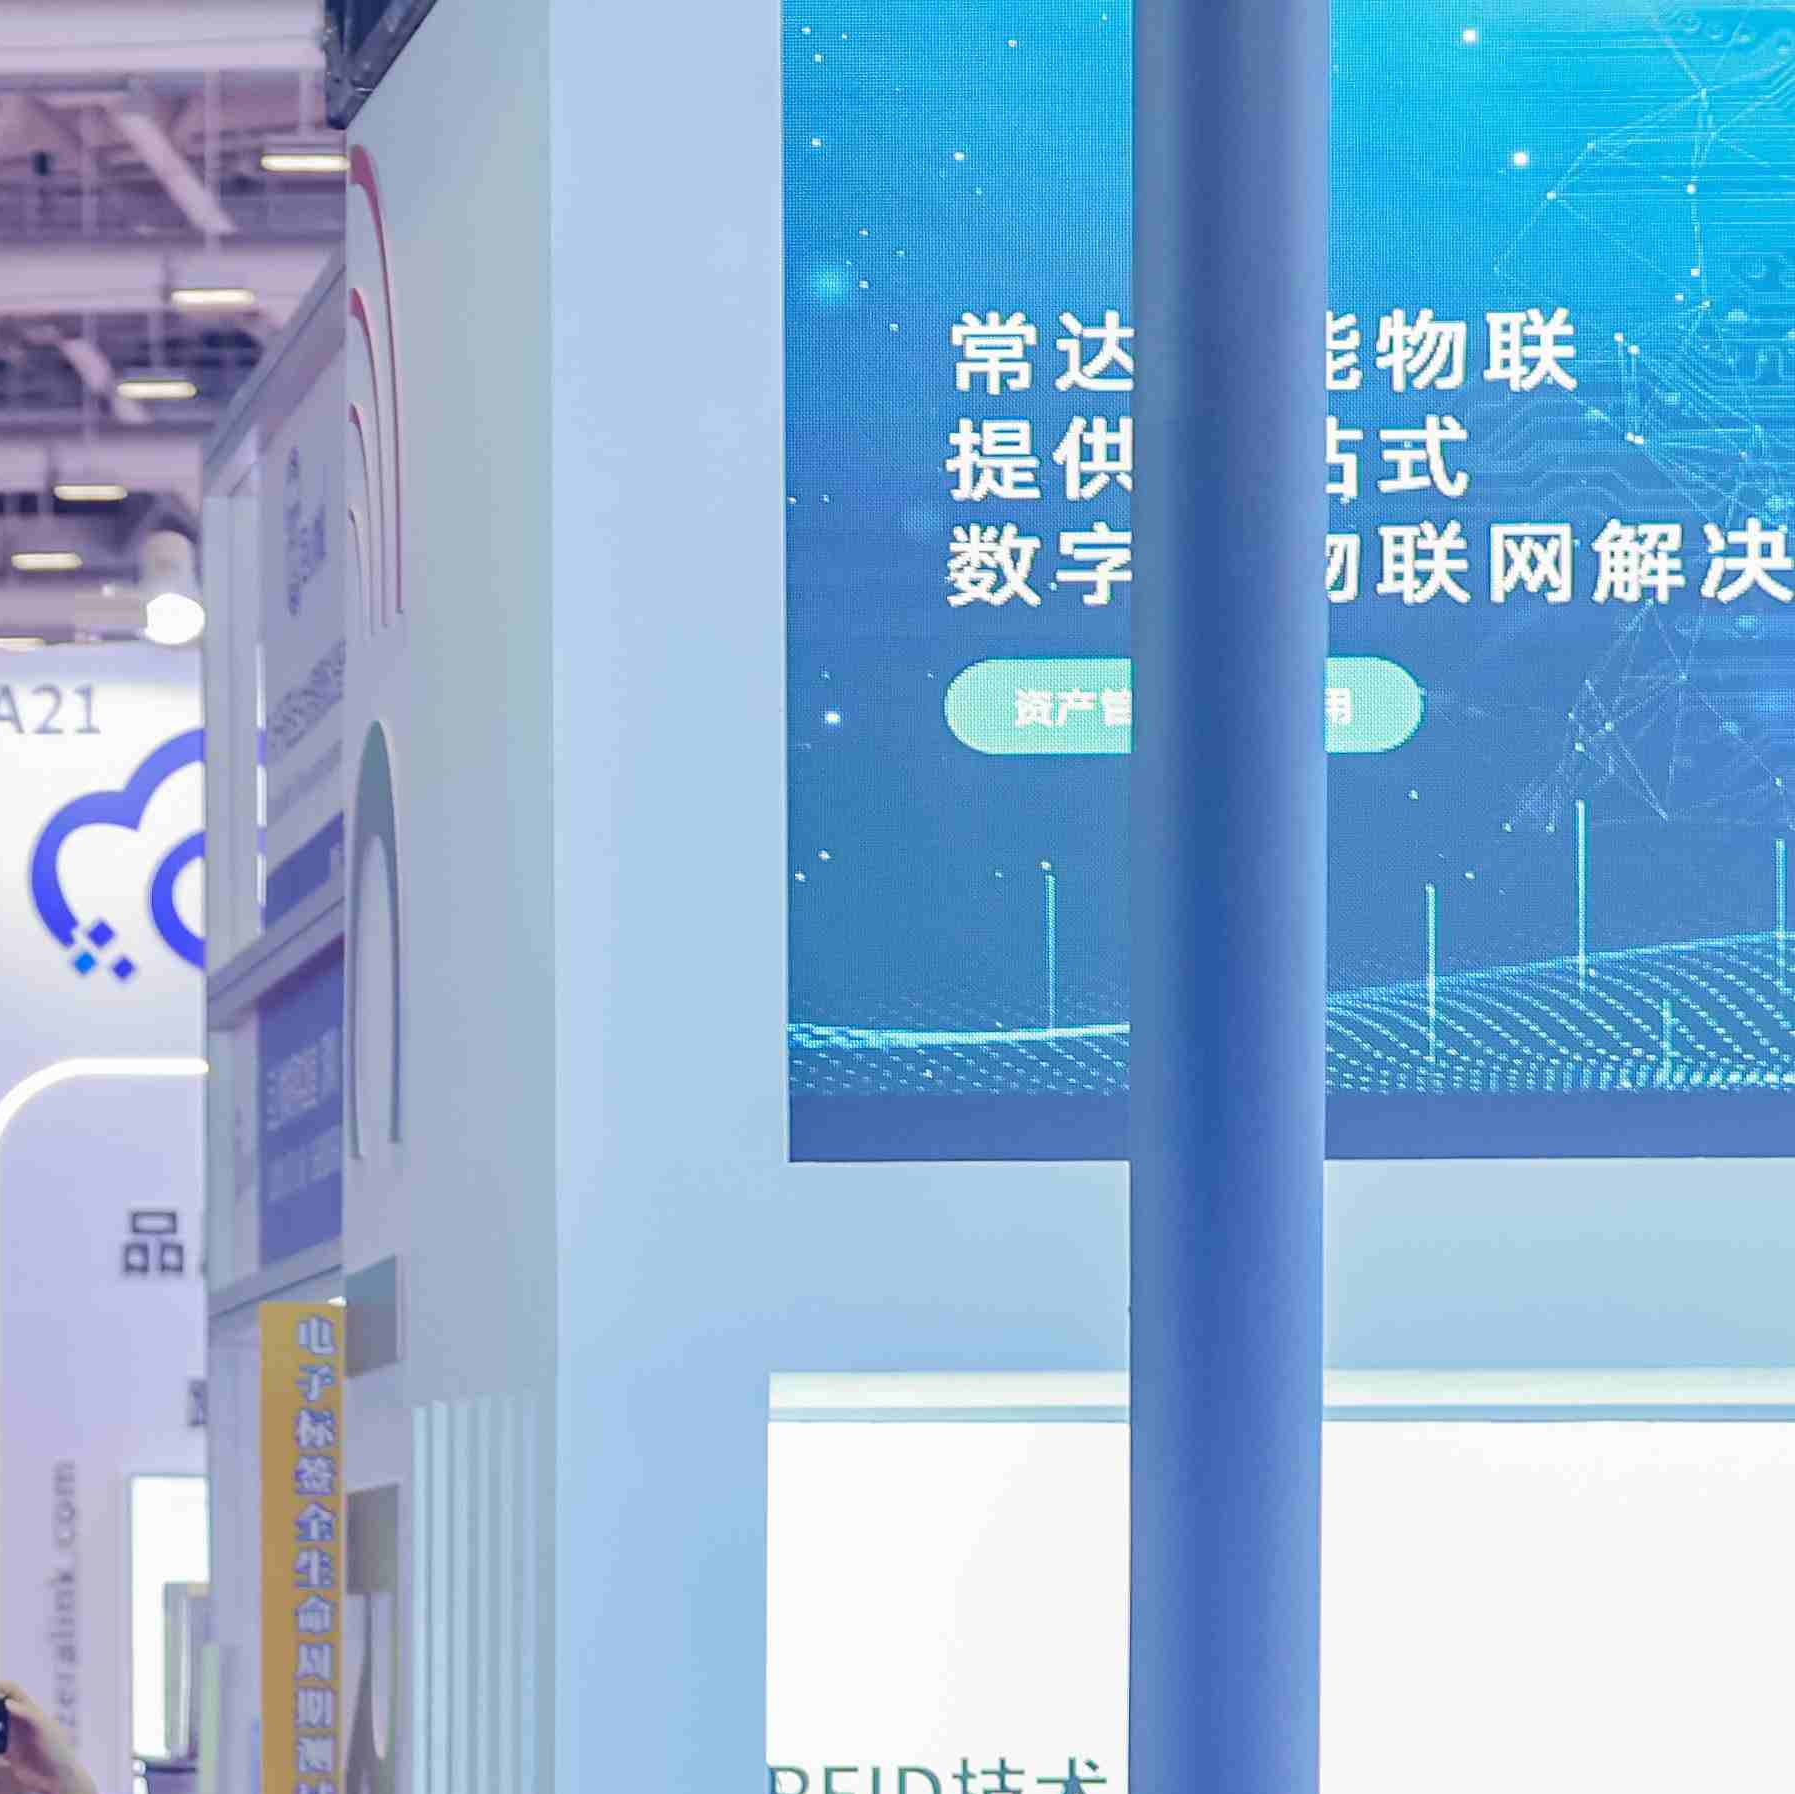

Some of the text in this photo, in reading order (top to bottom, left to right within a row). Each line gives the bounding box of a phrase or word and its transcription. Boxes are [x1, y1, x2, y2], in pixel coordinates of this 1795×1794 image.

[951, 310, 1577, 396] 常达物联
[944, 414, 1469, 502] 提供式
[945, 518, 1795, 607] 数字联网解决
